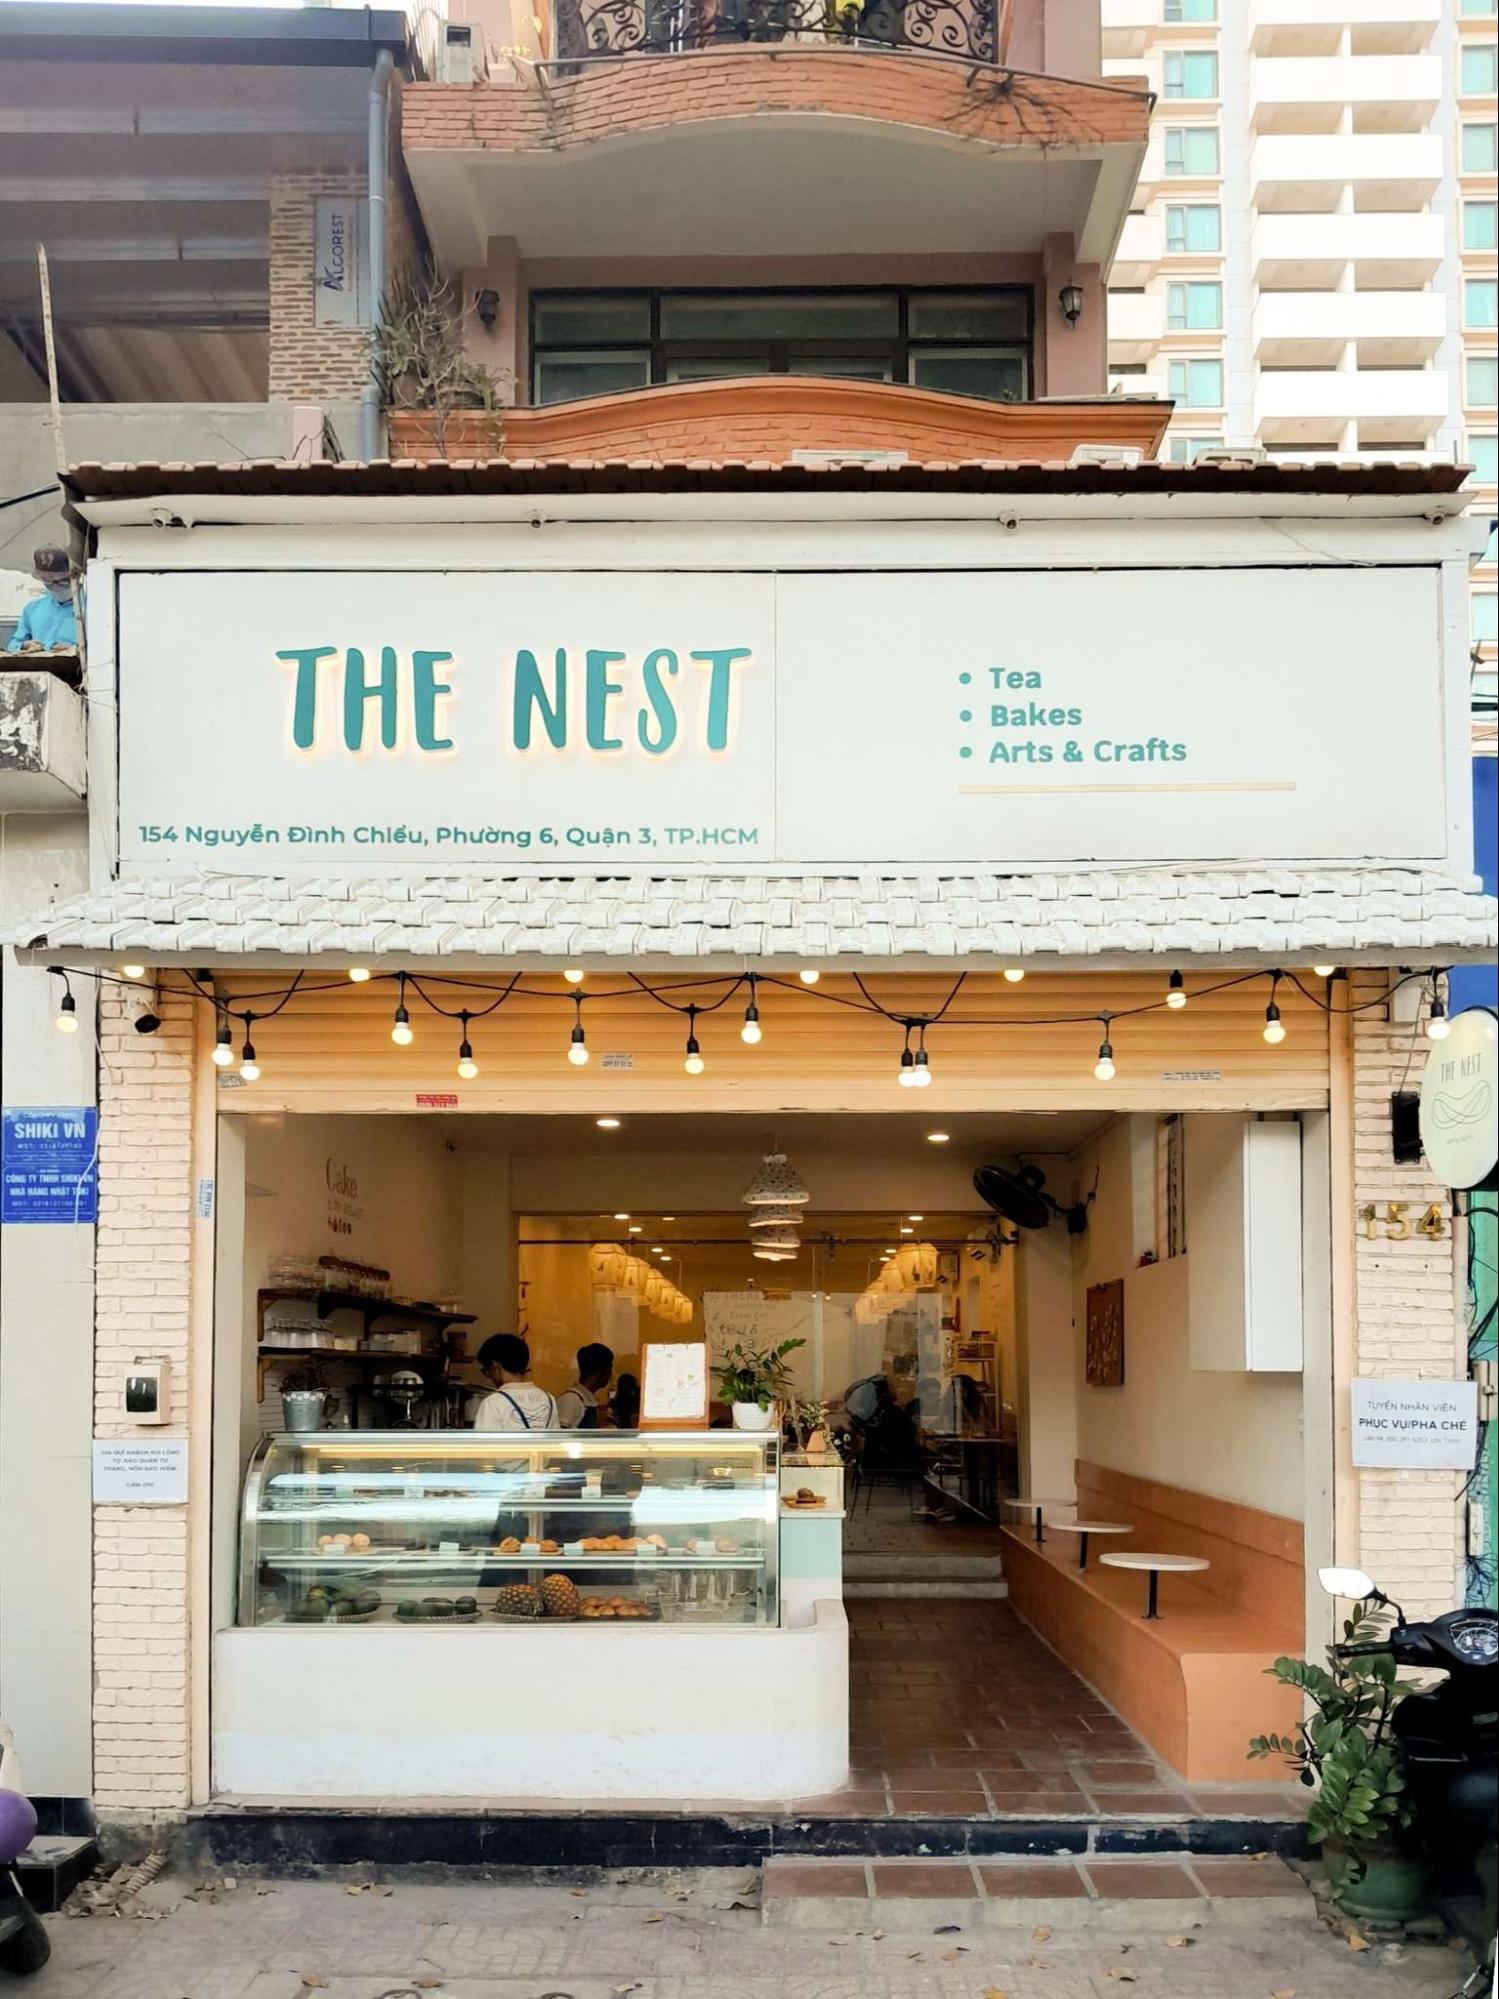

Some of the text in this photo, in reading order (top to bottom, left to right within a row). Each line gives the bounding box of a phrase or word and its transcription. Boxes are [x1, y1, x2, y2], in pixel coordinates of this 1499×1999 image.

[989, 666, 1042, 690] Tea
[276, 646, 752, 753] THE NEST
[990, 702, 1083, 727] Bakes
[989, 738, 1187, 763] Arts & Crafts
[139, 826, 178, 842] 154
[186, 823, 279, 847] Nguyễn
[287, 826, 345, 843] Đình
[436, 827, 531, 848] Phường
[539, 827, 558, 846] 6,
[566, 827, 631, 848] Quận
[639, 827, 657, 846] 3,
[664, 827, 758, 845] TP.HCM
[1440, 1052, 1481, 1083] THE NEST
[15, 1122, 86, 1138] SHIKI VN
[1359, 1203, 1445, 1241] 154
